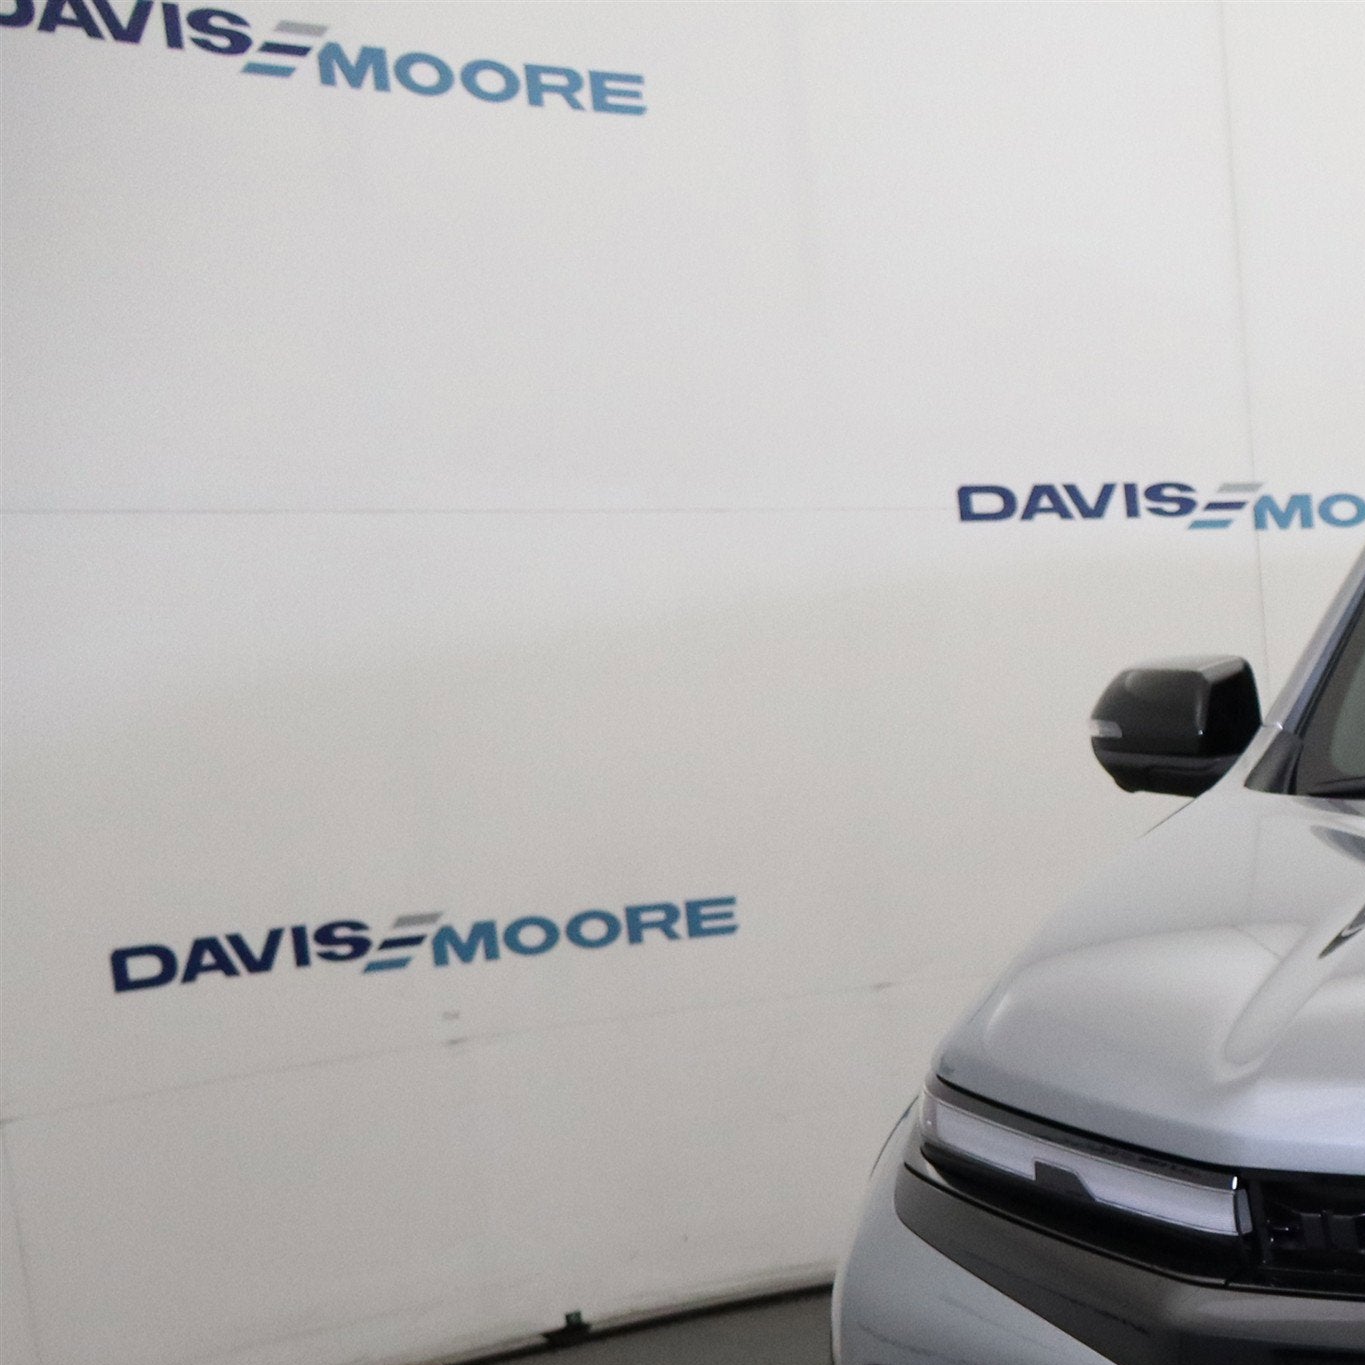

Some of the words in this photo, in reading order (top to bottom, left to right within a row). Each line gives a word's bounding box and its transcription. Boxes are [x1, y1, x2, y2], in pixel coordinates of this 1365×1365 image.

[317, 41, 648, 116] MOORE
[957, 481, 1199, 522] DAVIS
[110, 919, 373, 993] DAVIS
[431, 896, 739, 968] MOORE
